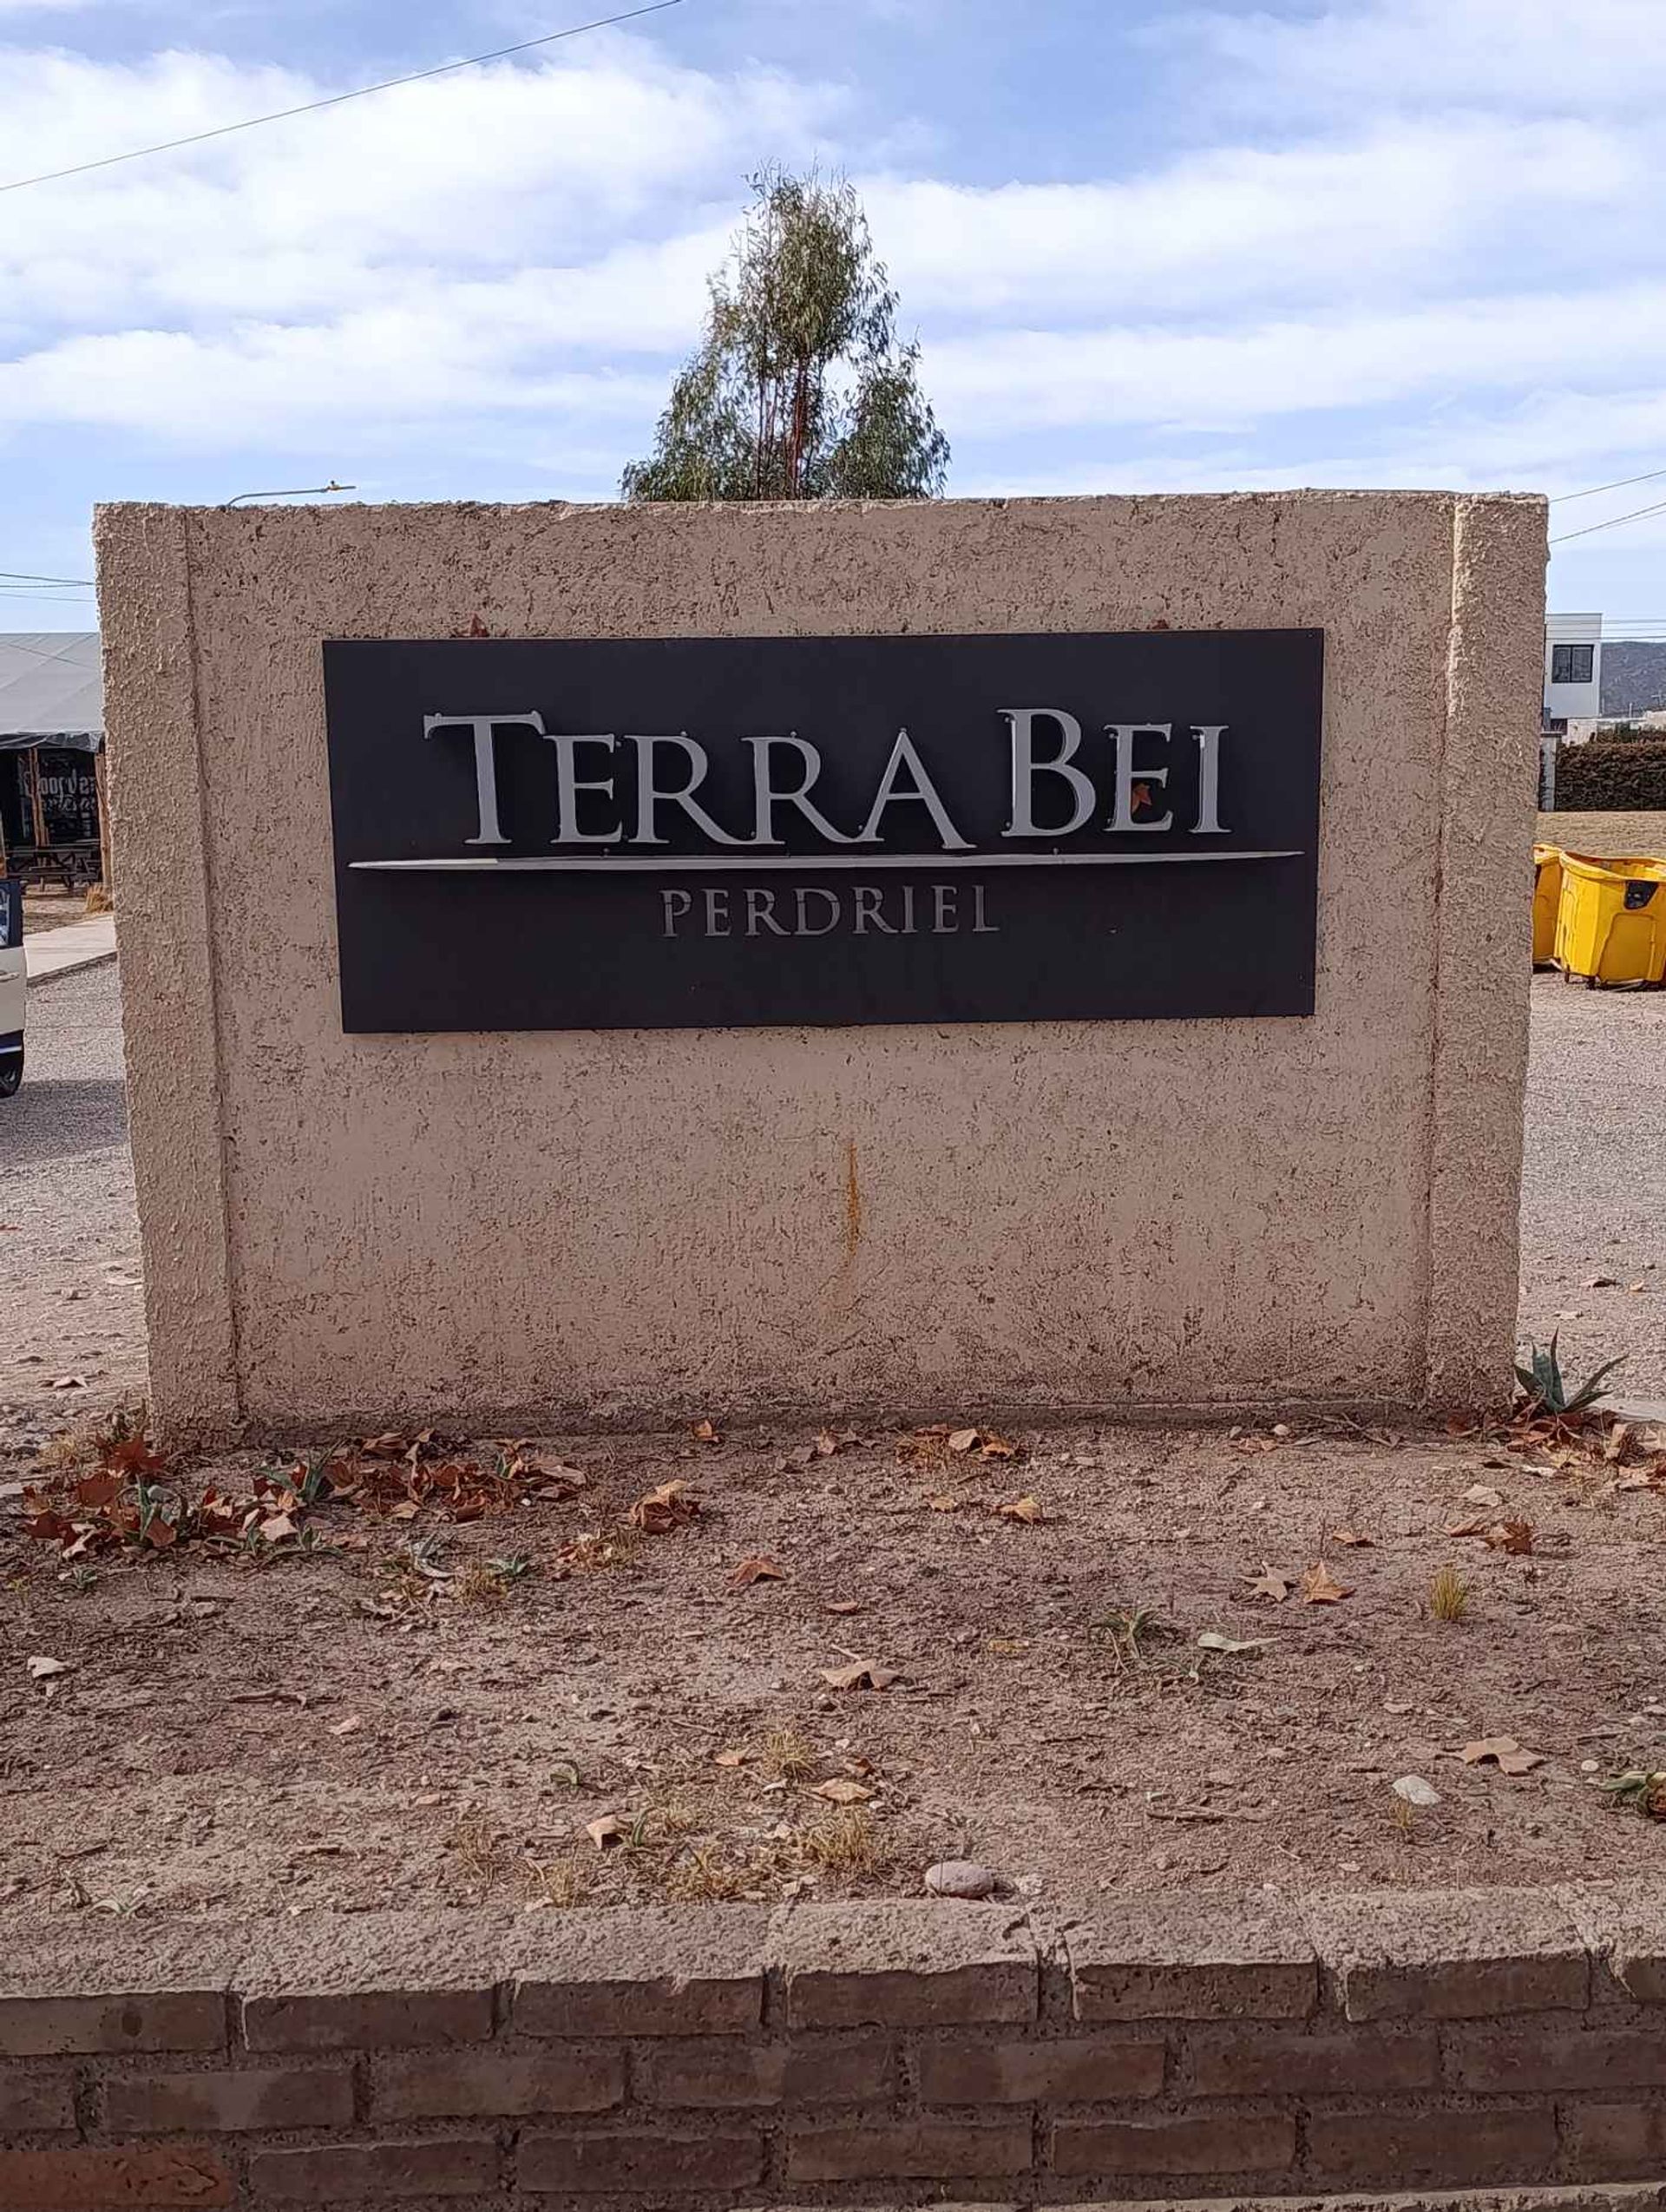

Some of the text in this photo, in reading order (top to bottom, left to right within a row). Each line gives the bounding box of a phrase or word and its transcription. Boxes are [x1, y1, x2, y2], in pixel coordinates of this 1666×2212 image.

[423, 707, 1232, 849] TERRA BEI
[658, 884, 1000, 938] PERDRIEL
